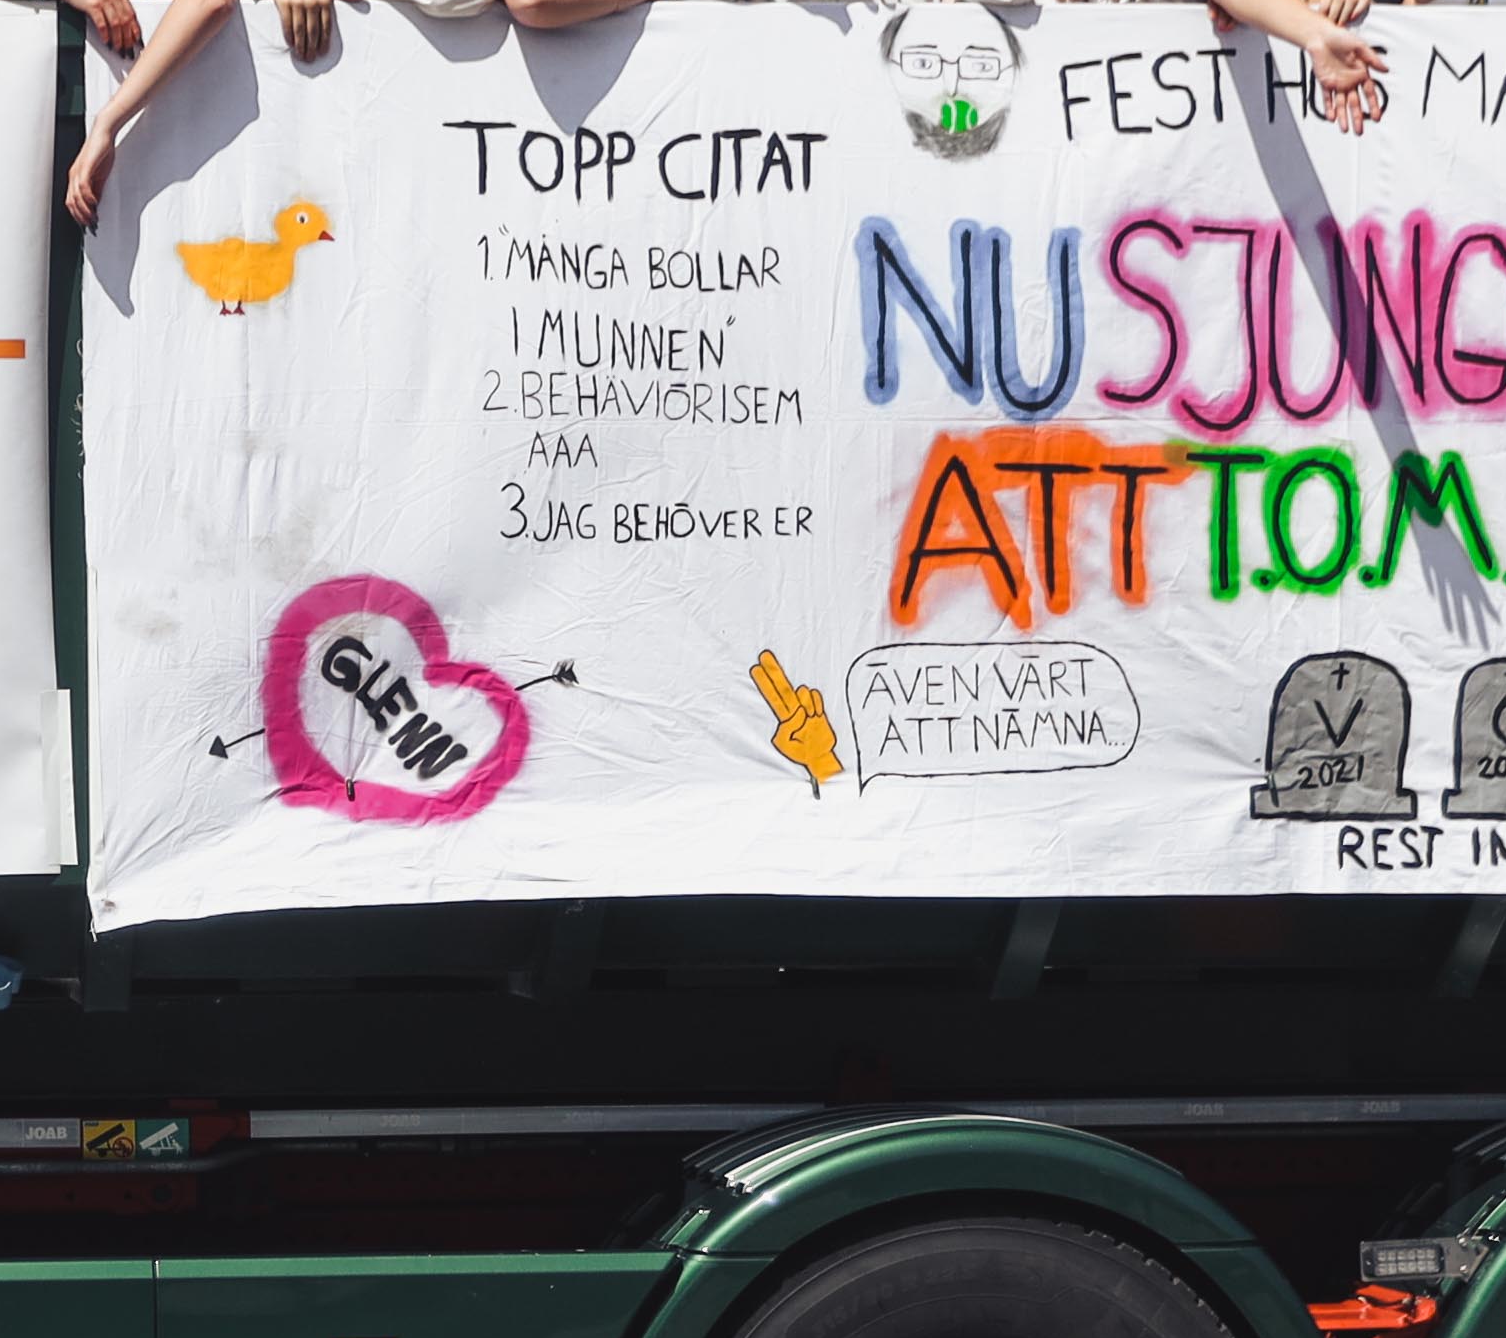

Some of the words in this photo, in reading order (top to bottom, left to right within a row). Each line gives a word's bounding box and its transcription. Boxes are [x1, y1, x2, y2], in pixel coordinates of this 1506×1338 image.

[1059, 48, 1237, 141] FEST
[442, 119, 636, 205] TOPP
[658, 128, 829, 204] CITAT
[648, 246, 781, 292] BOLLAR
[855, 215, 1085, 421] NU
[527, 430, 599, 468] AAA
[774, 506, 814, 537] ER
[889, 426, 1188, 631] ATT
[318, 635, 469, 781] GLENN
[1318, 696, 1365, 750] V
[877, 711, 964, 758] ATT
[1296, 756, 1365, 791] 2021
[1337, 825, 1443, 873] REST
[25, 1126, 68, 1140] JOAB
